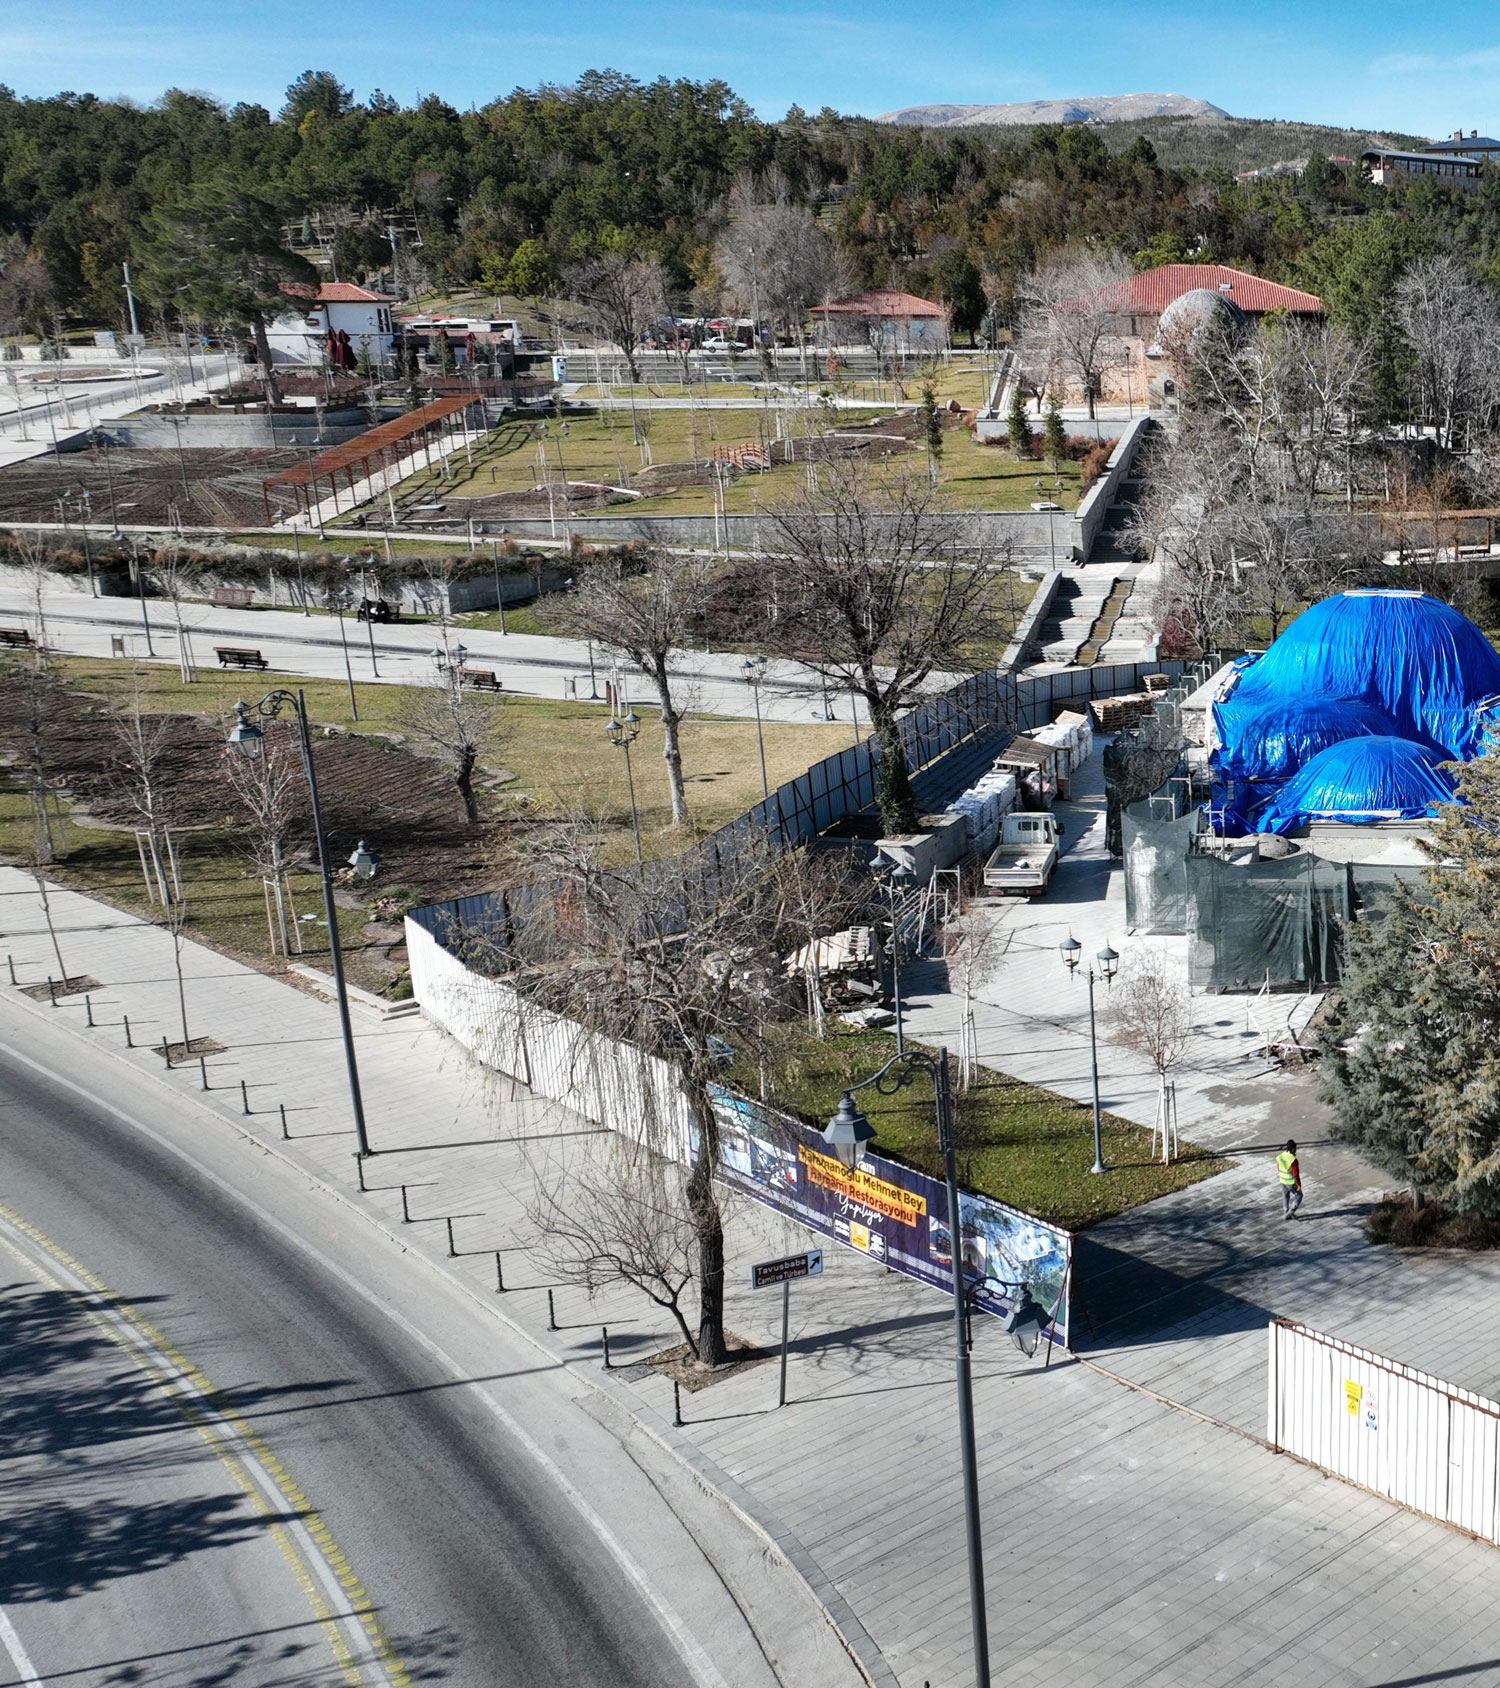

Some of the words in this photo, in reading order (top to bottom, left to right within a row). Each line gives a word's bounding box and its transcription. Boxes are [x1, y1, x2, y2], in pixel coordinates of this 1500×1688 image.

[849, 1186, 913, 1222] Restorasyonu
[863, 1175, 901, 1202] Mehmet
[904, 1193, 923, 1210] Bey
[757, 1258, 806, 1275] Tavusbaba
